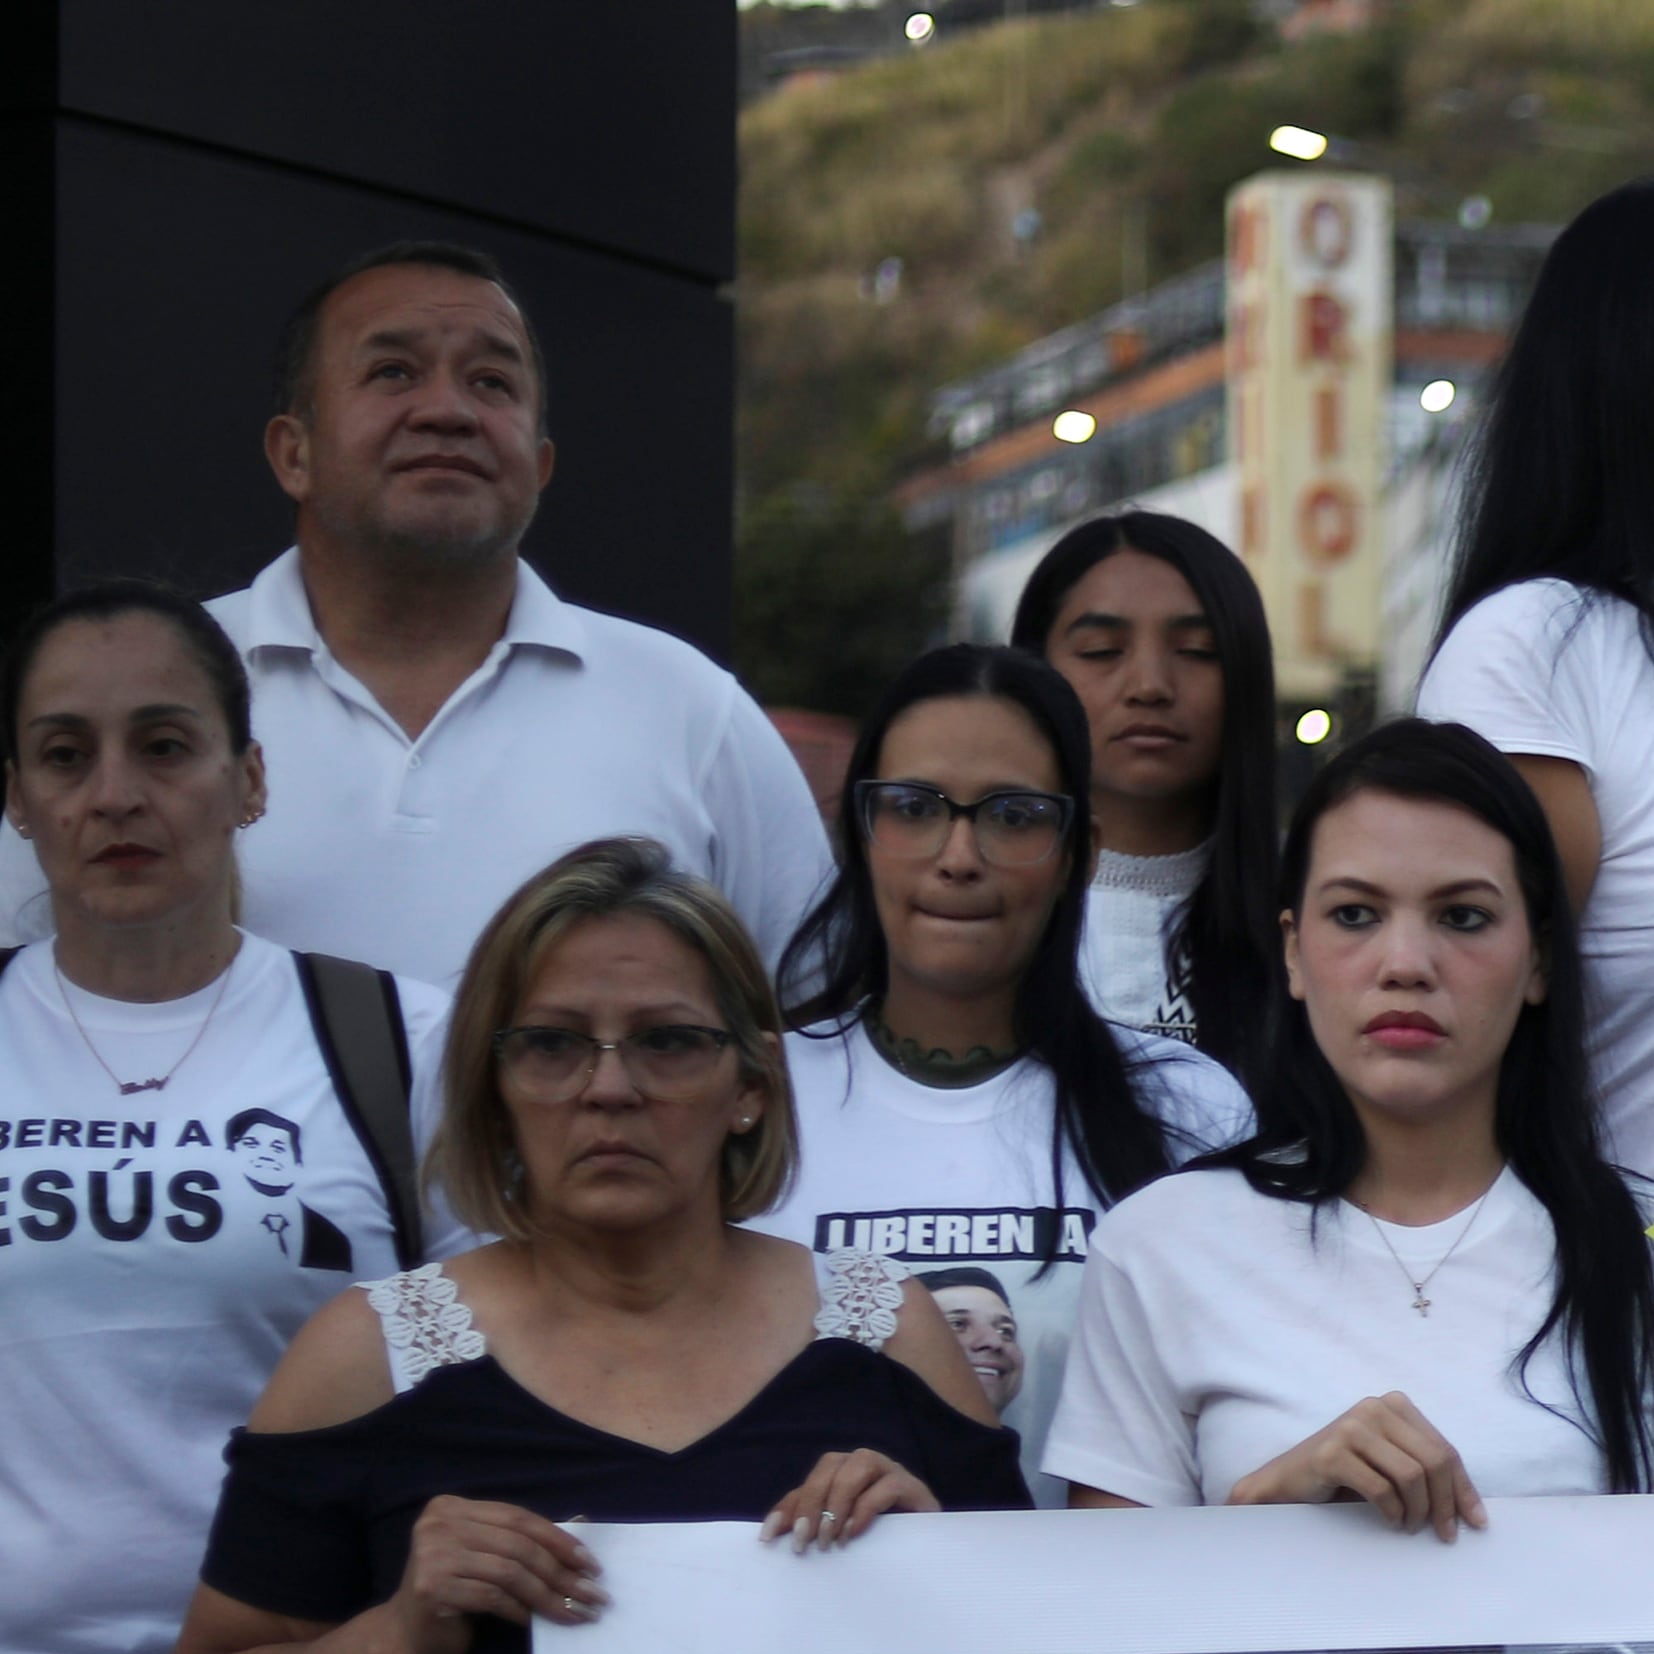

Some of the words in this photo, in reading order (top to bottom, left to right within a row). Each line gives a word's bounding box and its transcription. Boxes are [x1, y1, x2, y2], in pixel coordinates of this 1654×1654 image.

[176, 1119, 211, 1148] A
[828, 1213, 1034, 1256] LIBEREN
[1062, 1214, 1089, 1257] A
